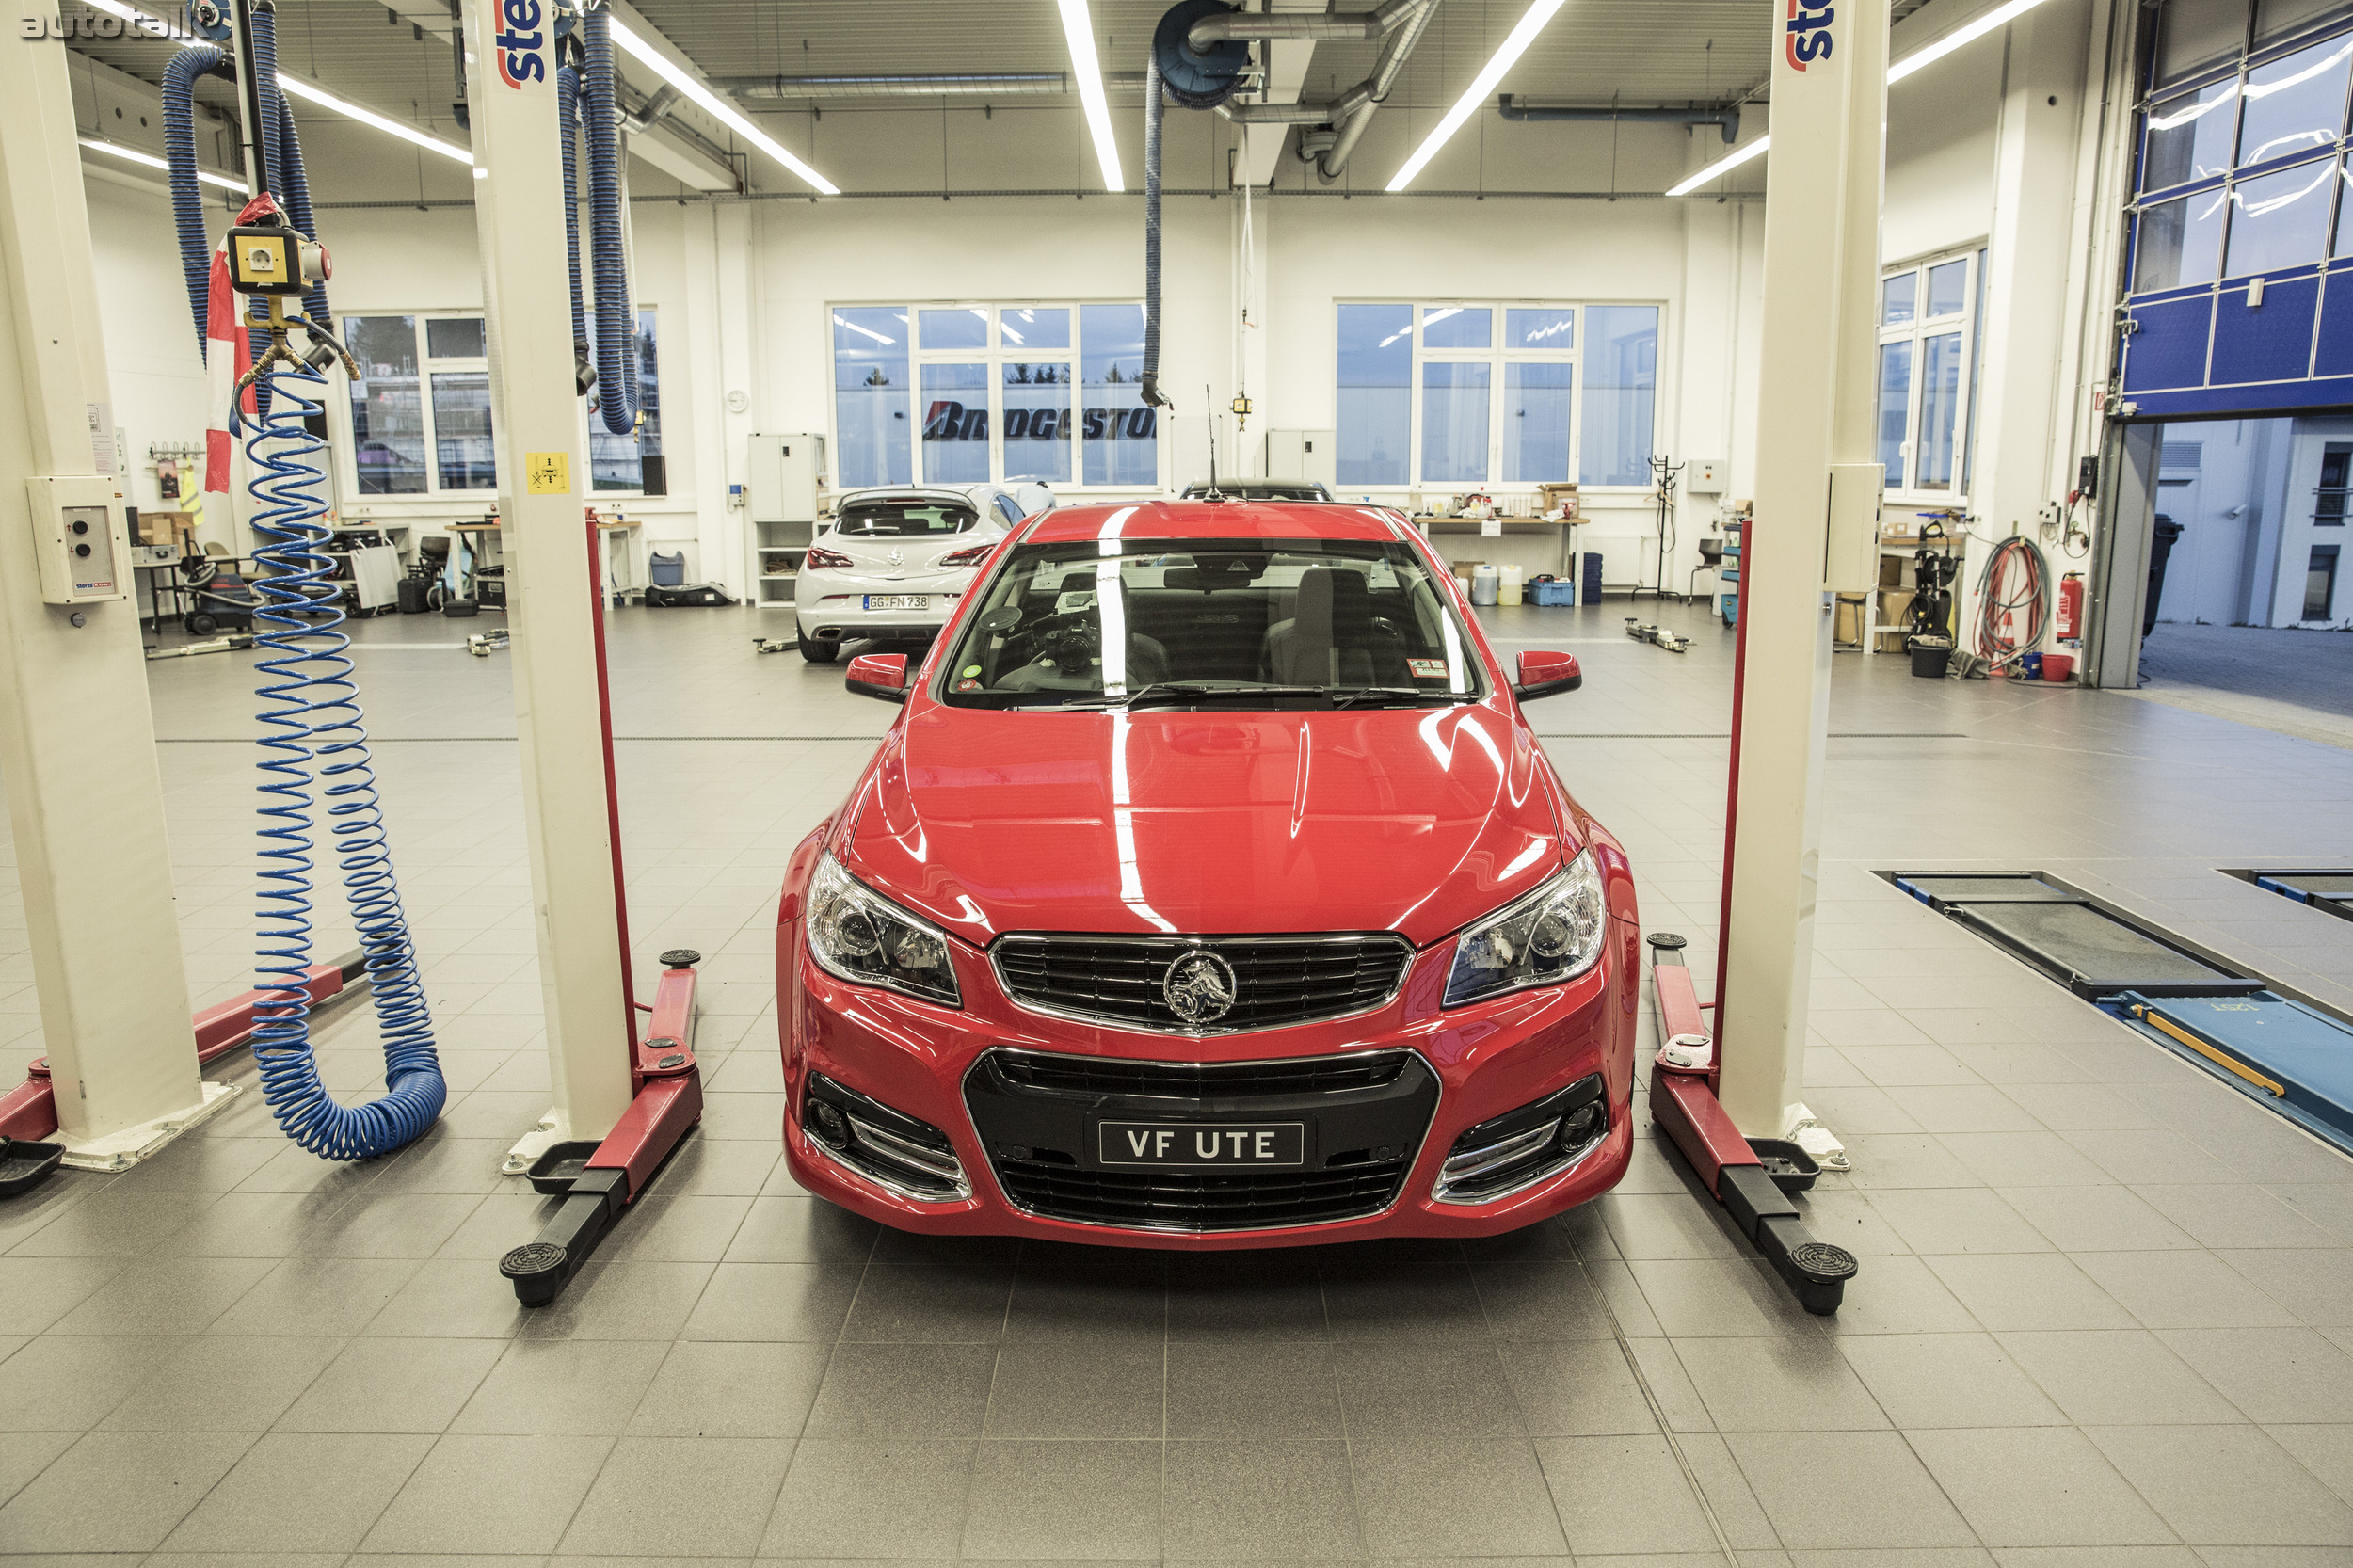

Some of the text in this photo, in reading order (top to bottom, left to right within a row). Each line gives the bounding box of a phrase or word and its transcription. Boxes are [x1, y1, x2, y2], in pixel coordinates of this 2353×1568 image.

[1786, 0, 1834, 61] st
[922, 401, 1157, 440] BRDGESTO
[870, 597, 927, 607] GG FN 738
[1127, 1130, 1275, 1159] VF UTE
